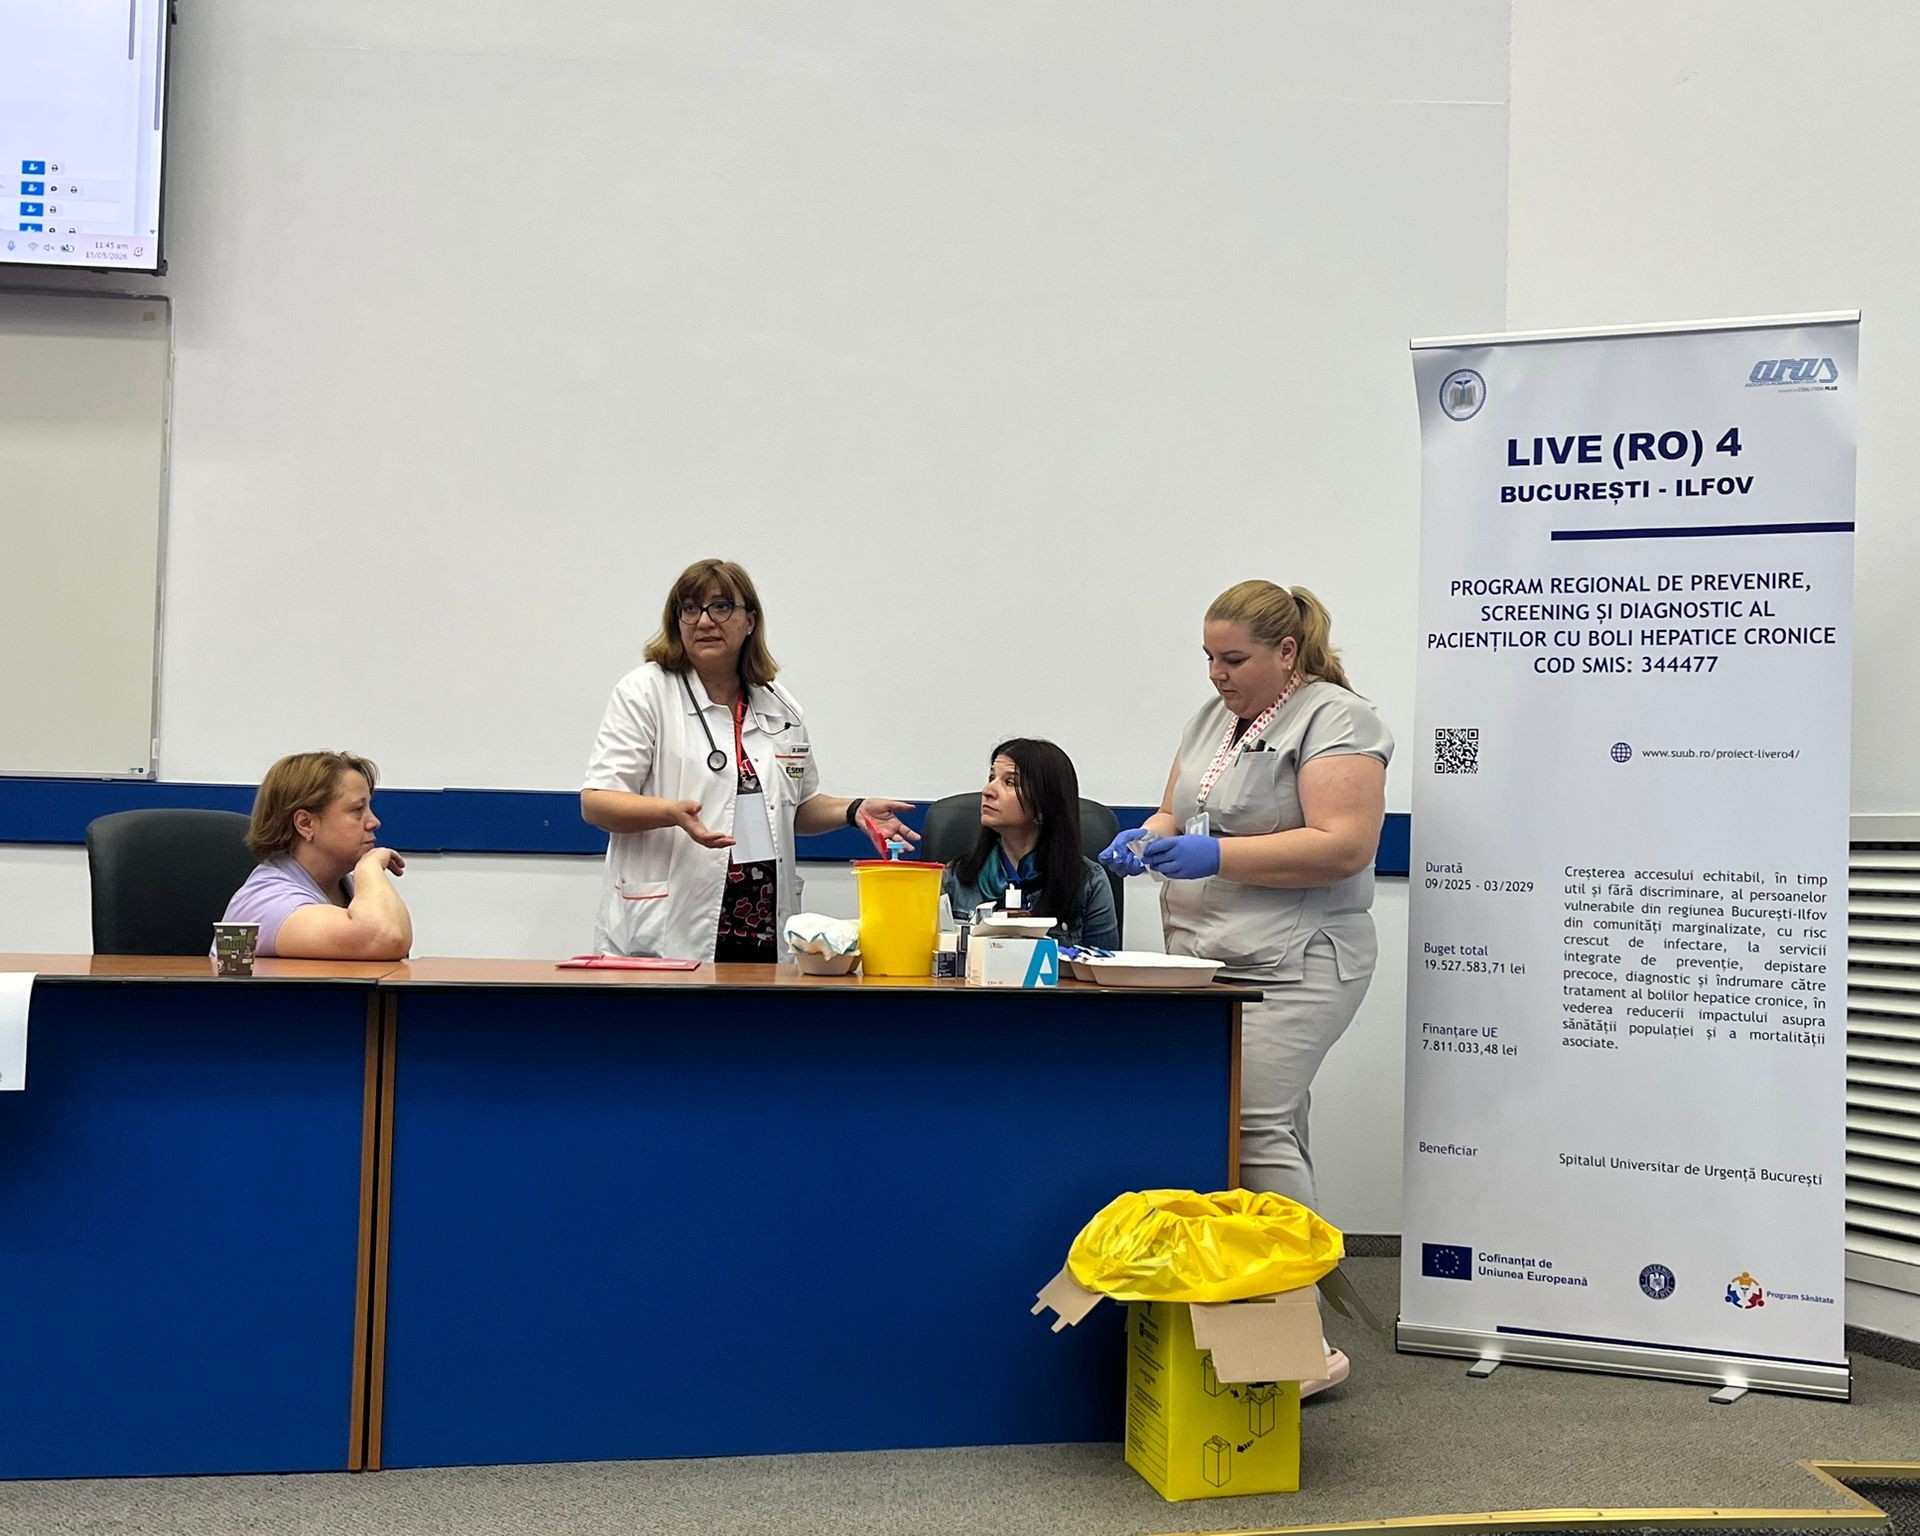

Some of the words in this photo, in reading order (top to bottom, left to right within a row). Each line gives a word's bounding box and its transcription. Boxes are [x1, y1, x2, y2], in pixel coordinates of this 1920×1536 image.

[1508, 435, 1602, 467] LIVE
[1613, 430, 1703, 470] (RO)
[1716, 427, 1742, 457] 4
[1501, 480, 1649, 505] BUCUREȘTI
[1676, 476, 1754, 497] ILFOV
[1451, 578, 1543, 596] PROGRAM
[1551, 576, 1651, 594] REGIONAL
[1658, 575, 1683, 591] DE
[1691, 572, 1811, 592] PREVENIRE,
[1481, 604, 1589, 621] SCREENING
[1597, 603, 1612, 624] ȘI
[1620, 601, 1743, 619] DIAGNOSTIC
[1749, 600, 1775, 617] AL
[1428, 631, 1547, 652] PACIENȚILOR
[1554, 630, 1580, 647] CU
[1589, 630, 1632, 646] BOLI
[1641, 628, 1737, 646] HEPATICE
[1744, 627, 1836, 645] CRONICE
[1534, 657, 1575, 673] COD
[1582, 656, 1632, 673] SMIS:
[1642, 656, 1718, 673] 344477
[1426, 861, 1463, 873] Durată
[1565, 866, 1625, 880] Creșterea
[1634, 869, 1693, 881] accesului
[1703, 870, 1764, 885] echitabil,
[1775, 871, 1787, 884] în
[1797, 873, 1828, 888] timp
[1425, 878, 1471, 890] 09/2025
[1484, 880, 1534, 892] 03/2029
[1564, 883, 1586, 894] util
[1592, 884, 1601, 898] și
[1608, 884, 1633, 896] fără
[1639, 885, 1724, 901] discriminare,
[1731, 888, 1743, 900] al
[1750, 891, 1827, 903] persoanelor
[1564, 900, 1635, 913] vulnerabile
[1641, 903, 1661, 914] din
[1668, 904, 1724, 918] regiunea
[1732, 906, 1827, 922] București-Ilfov
[1564, 916, 1583, 928] din
[1593, 919, 1661, 934] comunități
[1672, 922, 1765, 937] marginalizate,
[1777, 928, 1792, 937] cu
[1804, 927, 1827, 939] risc
[1424, 942, 1456, 957] Buget
[1460, 945, 1488, 956] total
[1563, 936, 1609, 946] crescut
[1628, 936, 1644, 948] de
[1663, 938, 1727, 953] infectare,
[1748, 941, 1760, 953] la
[1779, 944, 1826, 956] servicii
[1425, 959, 1504, 974] 19.527.583,71
[1510, 963, 1525, 974] lei
[1564, 950, 1621, 965] integrate
[1641, 954, 1656, 965] de
[1676, 958, 1743, 972] prevenție,
[1764, 960, 1827, 974] depistare
[1563, 970, 1617, 982] precoce,
[1625, 971, 1690, 985] diagnostic
[1698, 974, 1708, 988] și
[1716, 974, 1783, 989] îndrumare
[1791, 978, 1826, 992] către
[1563, 985, 1627, 999] tratament
[1631, 988, 1643, 999] al
[1647, 988, 1689, 1002] bolilor
[1694, 991, 1751, 1006] hepatice
[1755, 994, 1807, 1010] cronice,
[1813, 996, 1826, 1009] în
[1562, 1002, 1613, 1015] vederea
[1627, 1005, 1684, 1019] reducerii
[1699, 1009, 1767, 1024] impactului
[1782, 1016, 1825, 1029] asupra
[1422, 1023, 1478, 1038] Finanțare
[1482, 1026, 1498, 1038] UE
[1562, 1018, 1617, 1034] sănătății
[1629, 1023, 1694, 1038] populației
[1706, 1027, 1716, 1040] și
[1729, 1030, 1737, 1039] a
[1749, 1029, 1825, 1046] mortalității
[1422, 1039, 1498, 1055] 7.811.033,48
[1502, 1044, 1517, 1056] lei
[1562, 1037, 1618, 1049] asociate.
[1419, 1141, 1478, 1156] Beneficiar
[1559, 1153, 1606, 1167] Spitalul
[1610, 1157, 1680, 1173] Universitar
[1684, 1164, 1700, 1175] de
[1705, 1165, 1756, 1182] Urgență
[1761, 1169, 1822, 1187] București
[1478, 1252, 1535, 1269] Cofinanțat
[1539, 1258, 1553, 1268] de
[1478, 1266, 1524, 1279] Uniunea
[1527, 1271, 1588, 1286] Europeană
[1766, 1290, 1799, 1302] Program
